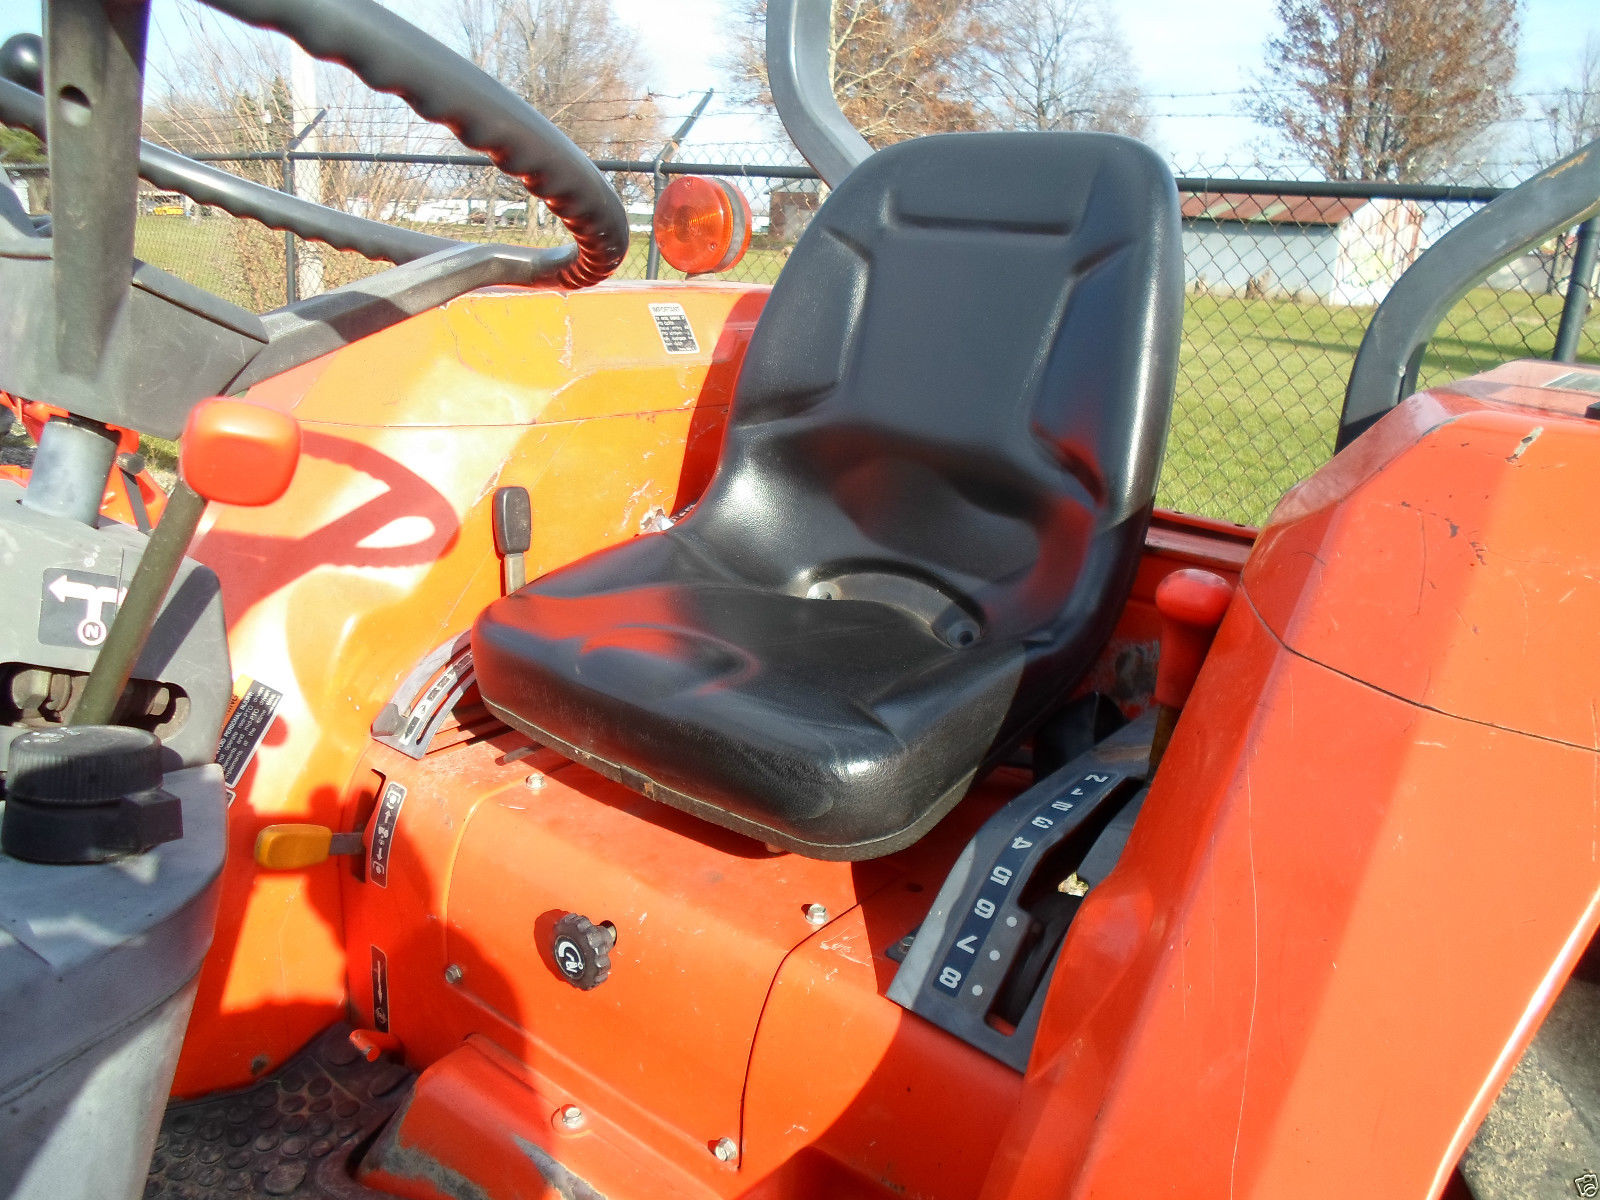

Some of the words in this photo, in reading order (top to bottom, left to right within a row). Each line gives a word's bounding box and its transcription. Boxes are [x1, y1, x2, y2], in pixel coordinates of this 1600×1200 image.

[84, 623, 99, 639] N
[224, 712, 242, 737] PERSONAL
[236, 733, 244, 745] and
[244, 708, 259, 732] mid-PTO
[1085, 774, 1108, 783] N
[1071, 787, 1083, 796] 1
[1051, 801, 1073, 812] 2
[1031, 816, 1054, 829] 3
[1011, 836, 1032, 850] 4
[990, 866, 1013, 886] 5
[974, 898, 996, 919] 6
[956, 935, 978, 954] 7
[939, 966, 962, 989] 8
